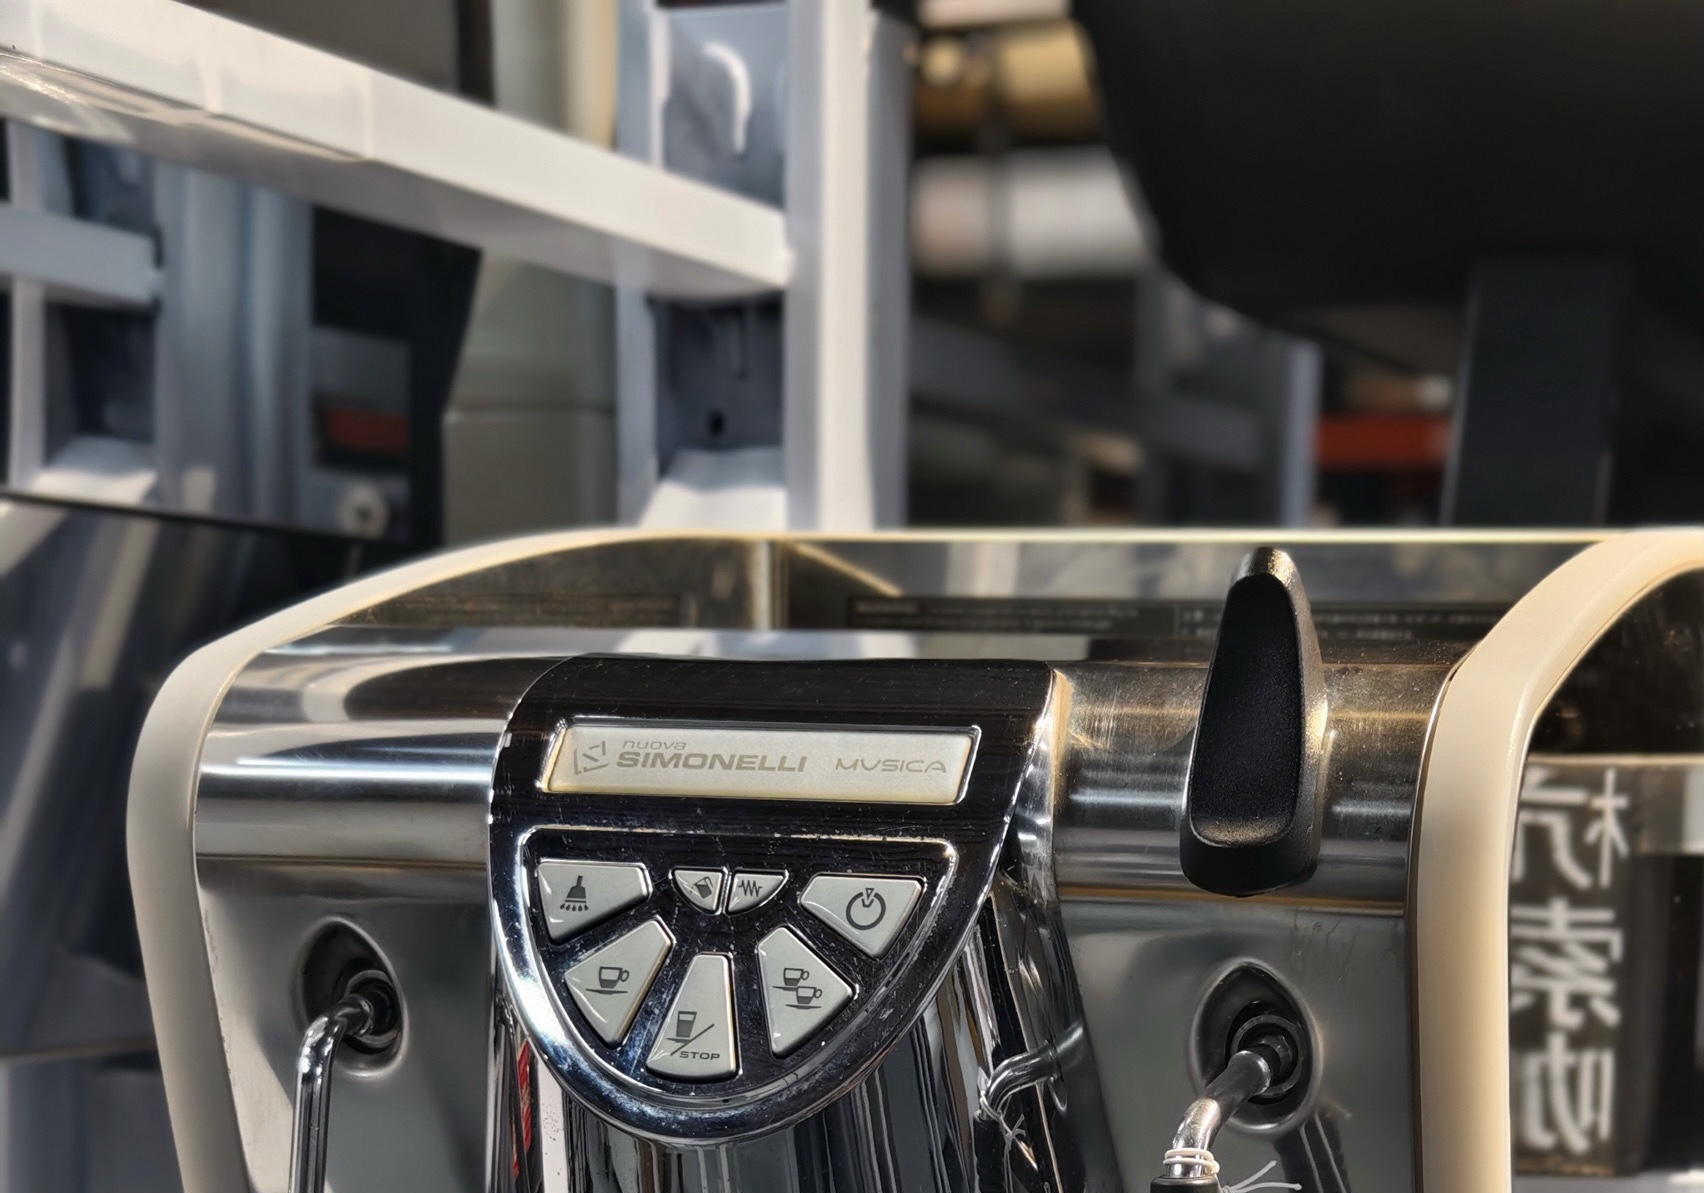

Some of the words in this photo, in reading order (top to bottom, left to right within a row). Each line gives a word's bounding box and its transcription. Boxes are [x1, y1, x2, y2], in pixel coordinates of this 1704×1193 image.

[622, 740, 687, 751] nuova
[616, 751, 808, 773] SIMONELLI
[834, 757, 948, 774] MVSICA
[680, 1050, 720, 1060] STOP
